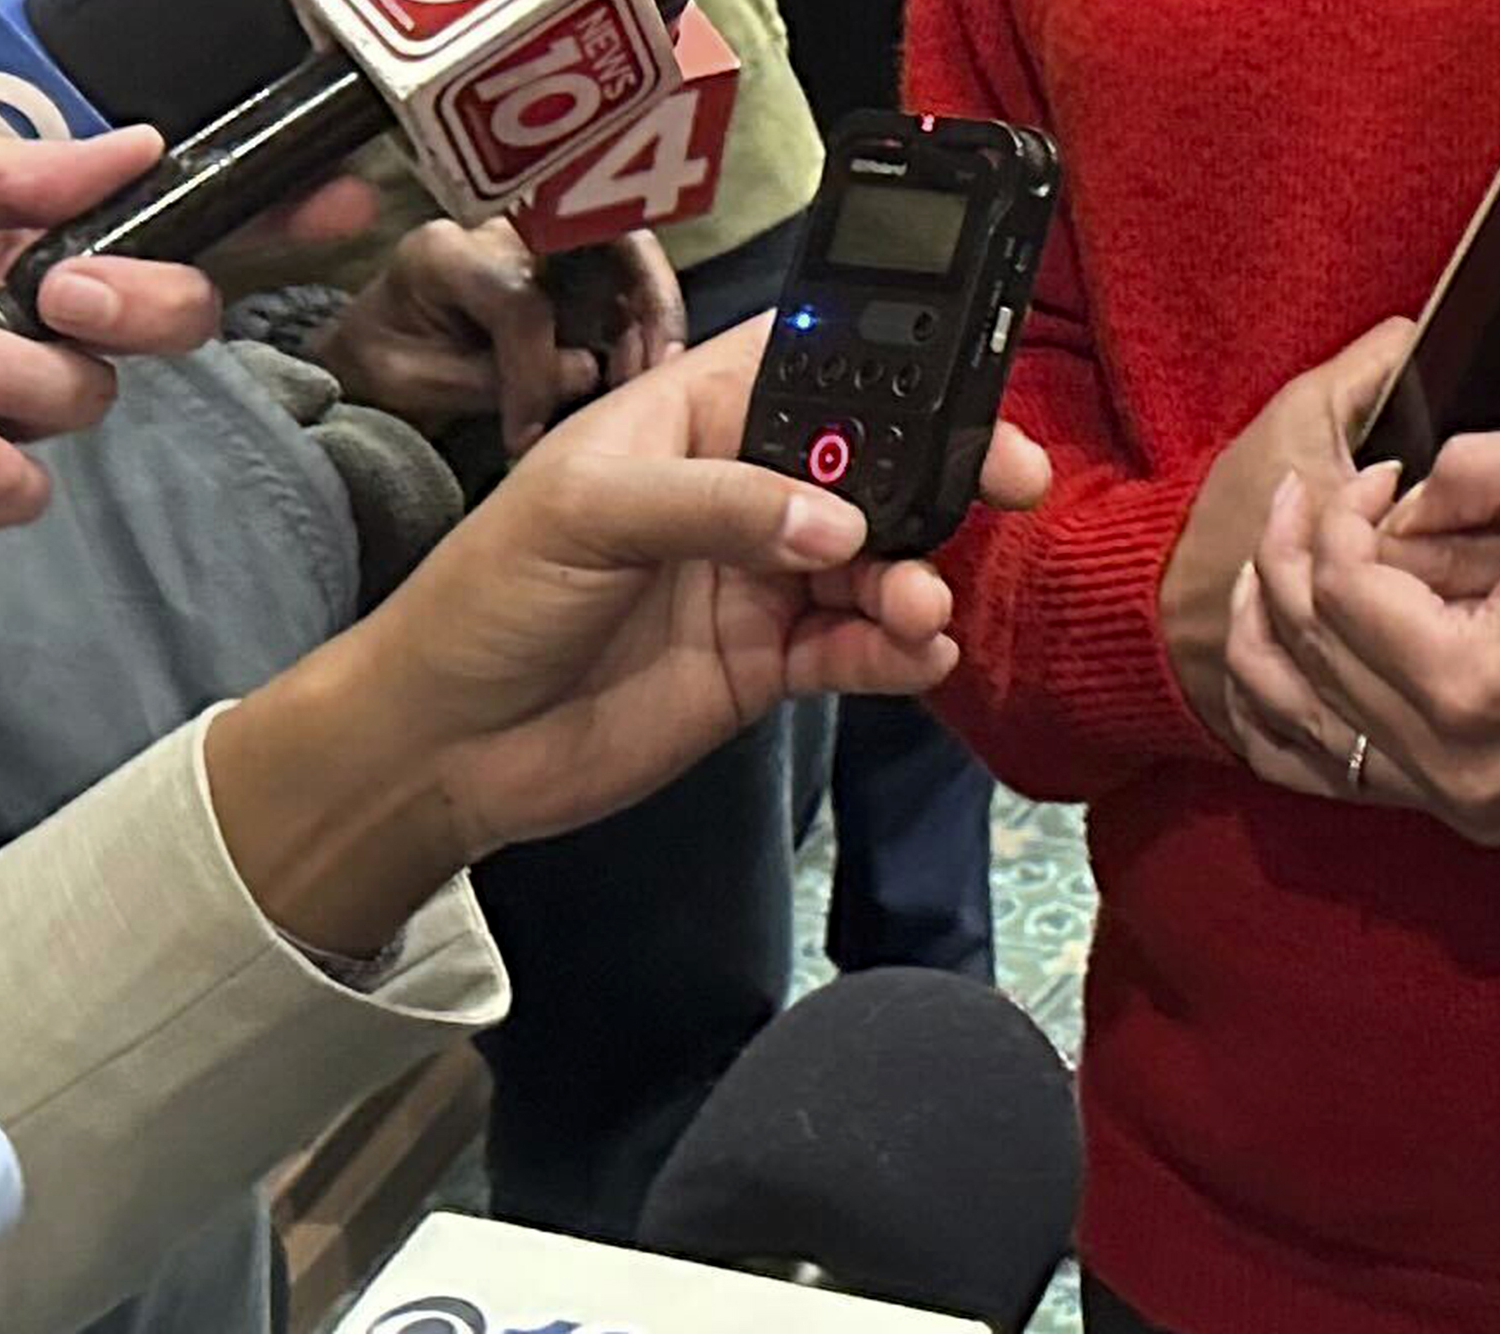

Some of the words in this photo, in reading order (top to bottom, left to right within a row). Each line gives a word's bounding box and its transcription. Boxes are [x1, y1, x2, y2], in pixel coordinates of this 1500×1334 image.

[474, 35, 601, 148] 10
[572, 5, 637, 100] NEWS
[555, 87, 708, 219] 4
